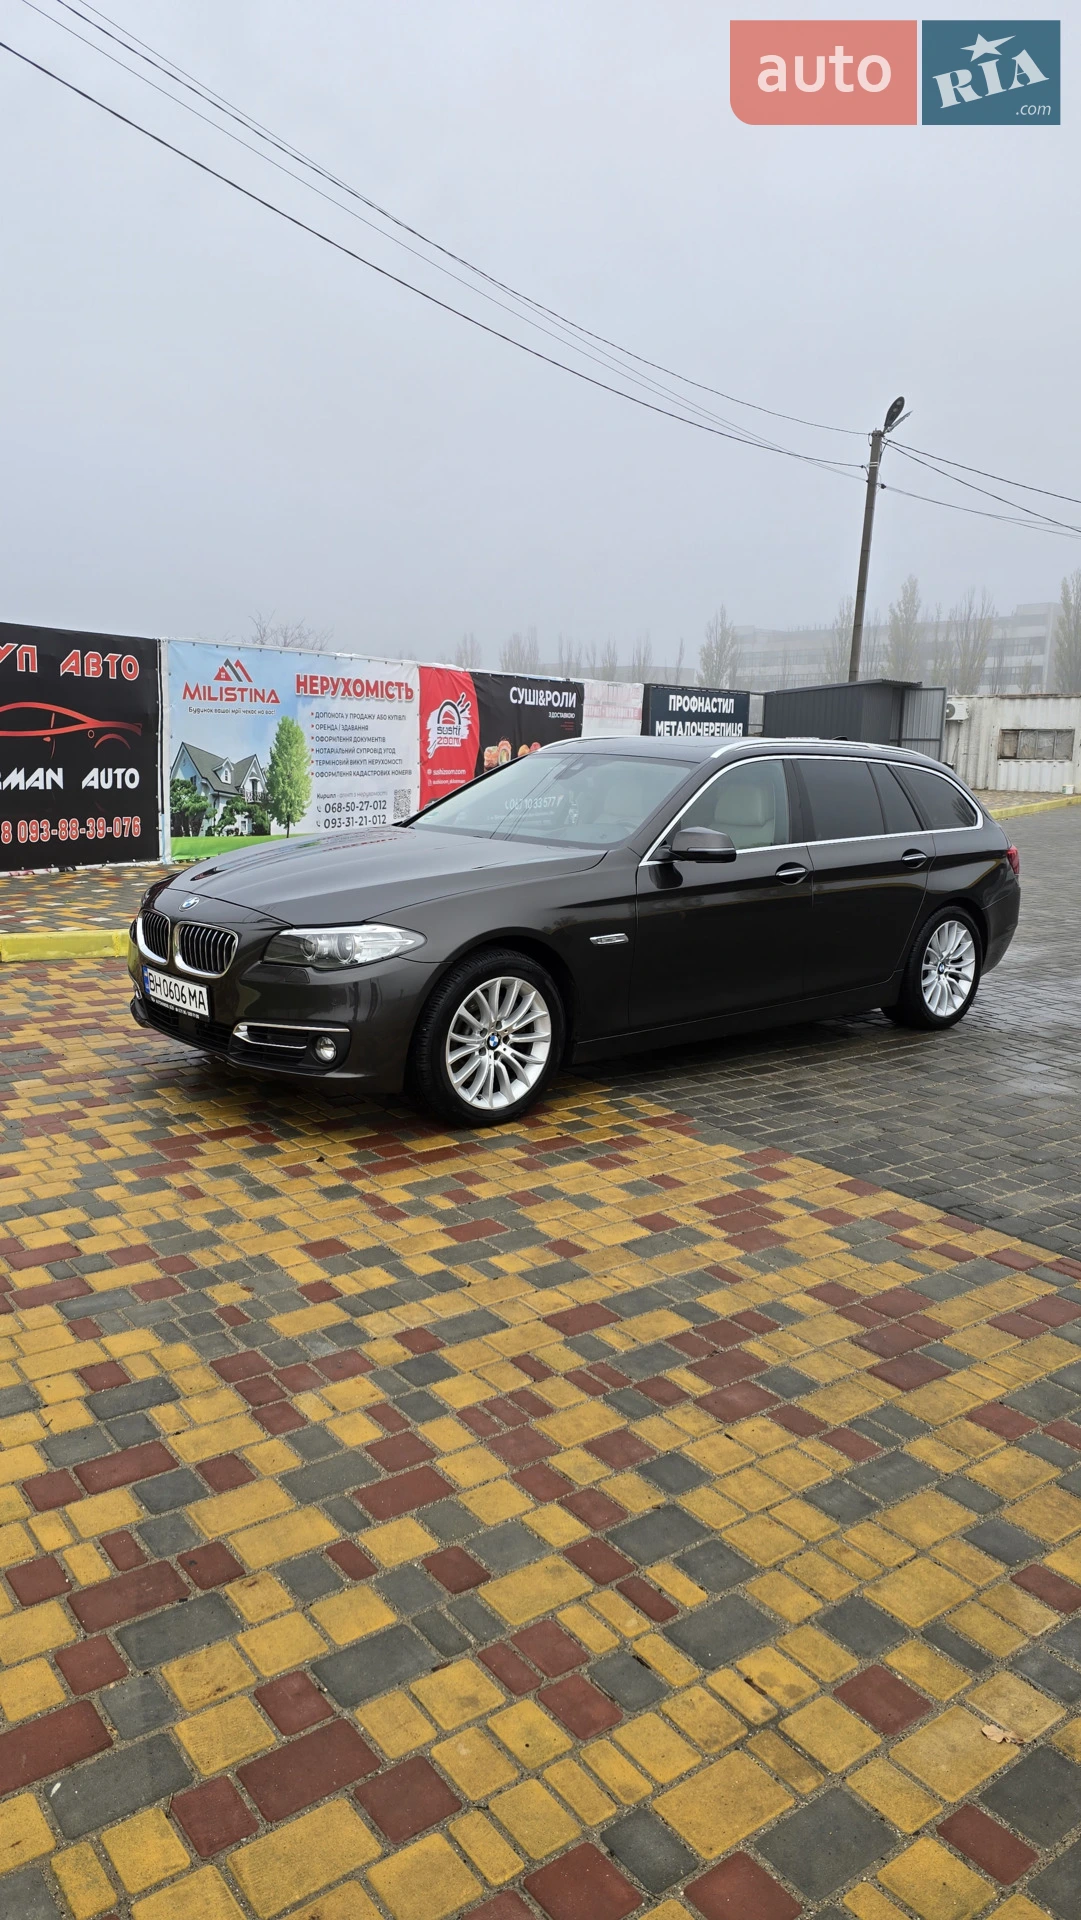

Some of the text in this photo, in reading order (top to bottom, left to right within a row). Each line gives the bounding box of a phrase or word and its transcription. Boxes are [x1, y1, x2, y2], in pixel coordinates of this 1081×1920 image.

[60, 649, 140, 681] АВТО
[182, 682, 281, 704] MILISTINA
[295, 673, 414, 700] НЕРУХОМІСТЬ
[509, 686, 577, 708] СУШІ&РОЛИ
[668, 694, 735, 714] ПРОФНАСТИЛ
[315, 735, 352, 743] ОФОРМЛЕННЯ
[655, 720, 743, 737] МЕТАЛОЧЕРЕПИЦЯ
[356, 747, 382, 755] СУПРОВІД
[383, 747, 396, 755] УГОД
[81, 767, 140, 790] AUTO
[324, 799, 387, 813] 068-50-27-012
[17, 816, 141, 844] 093-88-39-076
[323, 814, 387, 829] 093-31-21-012
